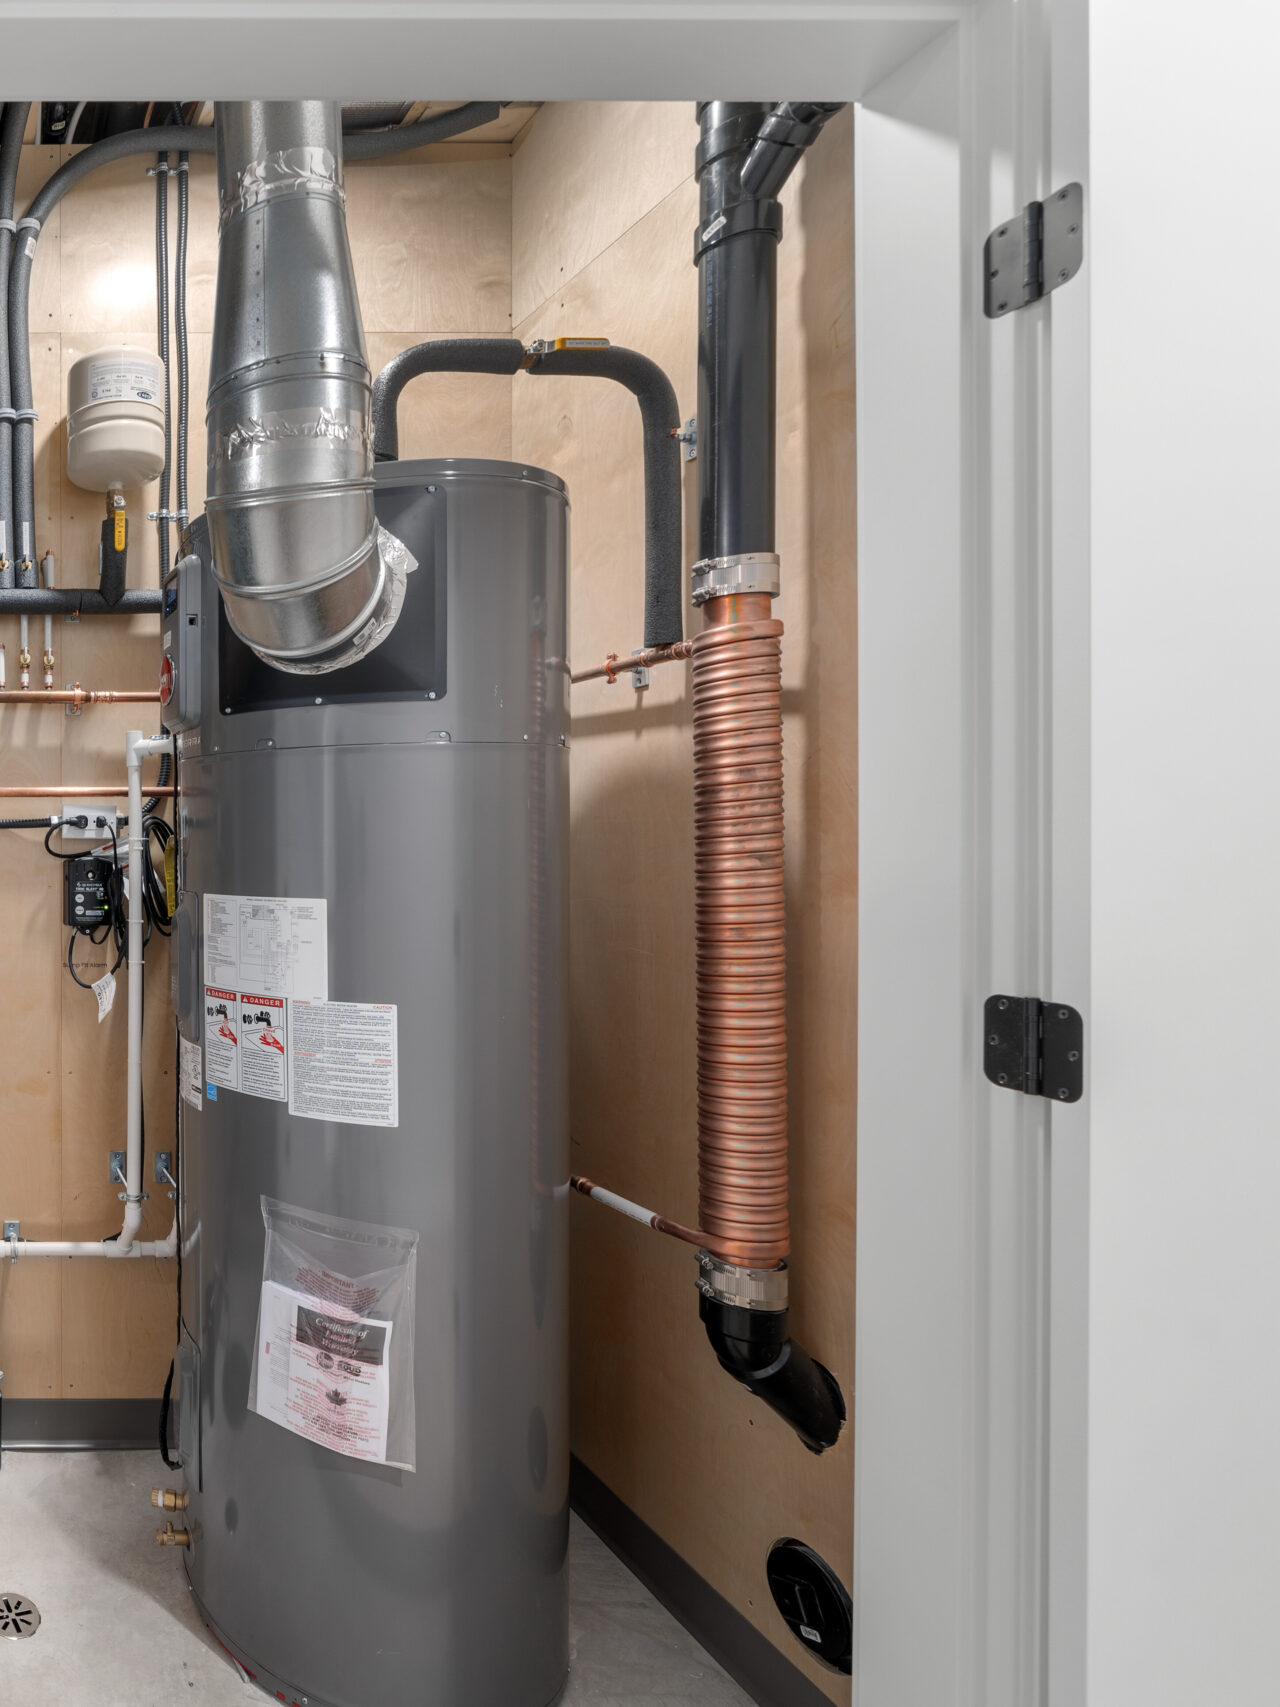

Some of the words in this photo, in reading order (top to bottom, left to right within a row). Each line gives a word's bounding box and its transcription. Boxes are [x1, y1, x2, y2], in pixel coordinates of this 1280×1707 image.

[211, 991, 235, 1000] DANGER
[249, 997, 280, 1006] DANGER
[322, 1270, 355, 1289] IMPORTANT
[315, 1317, 358, 1337] Certificate
[358, 1329, 370, 1339] of
